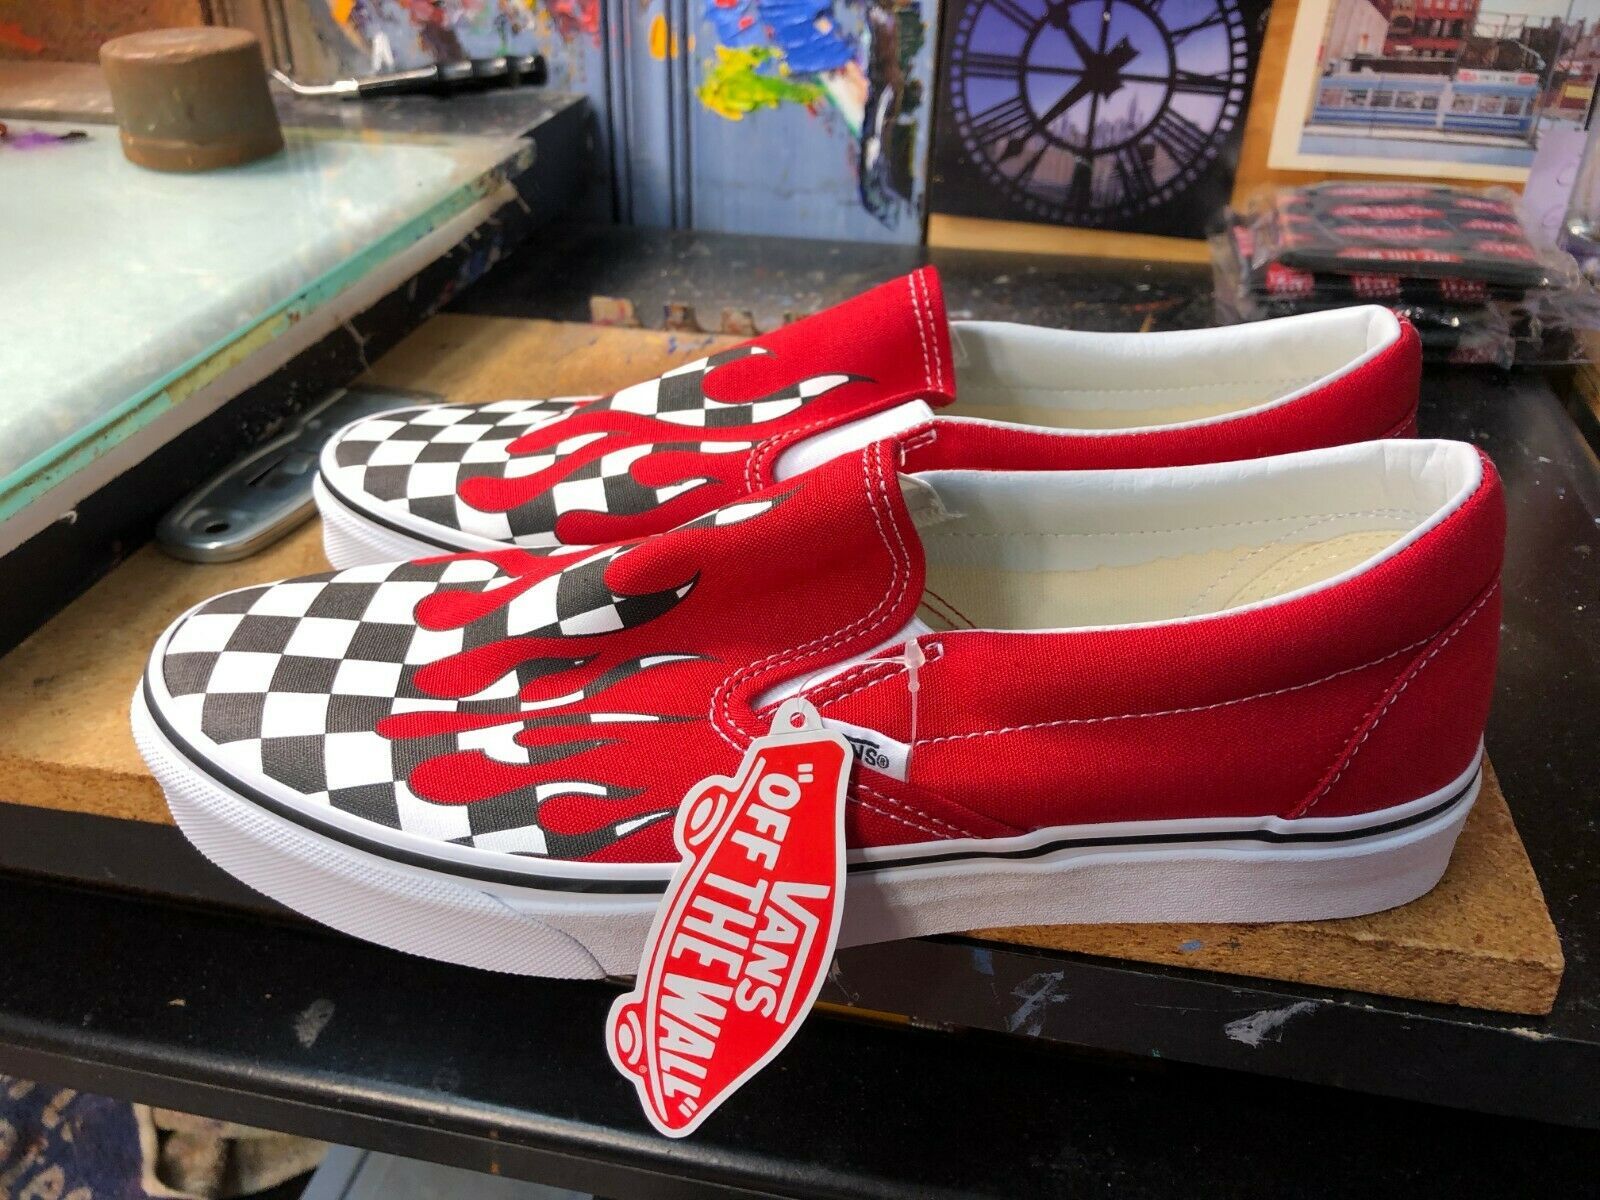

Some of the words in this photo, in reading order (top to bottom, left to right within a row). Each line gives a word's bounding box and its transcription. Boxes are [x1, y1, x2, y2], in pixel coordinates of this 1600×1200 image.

[730, 763, 814, 871] "OFF
[671, 872, 769, 980] THE
[736, 881, 831, 1025] VANS
[659, 973, 734, 1119] WALL"
